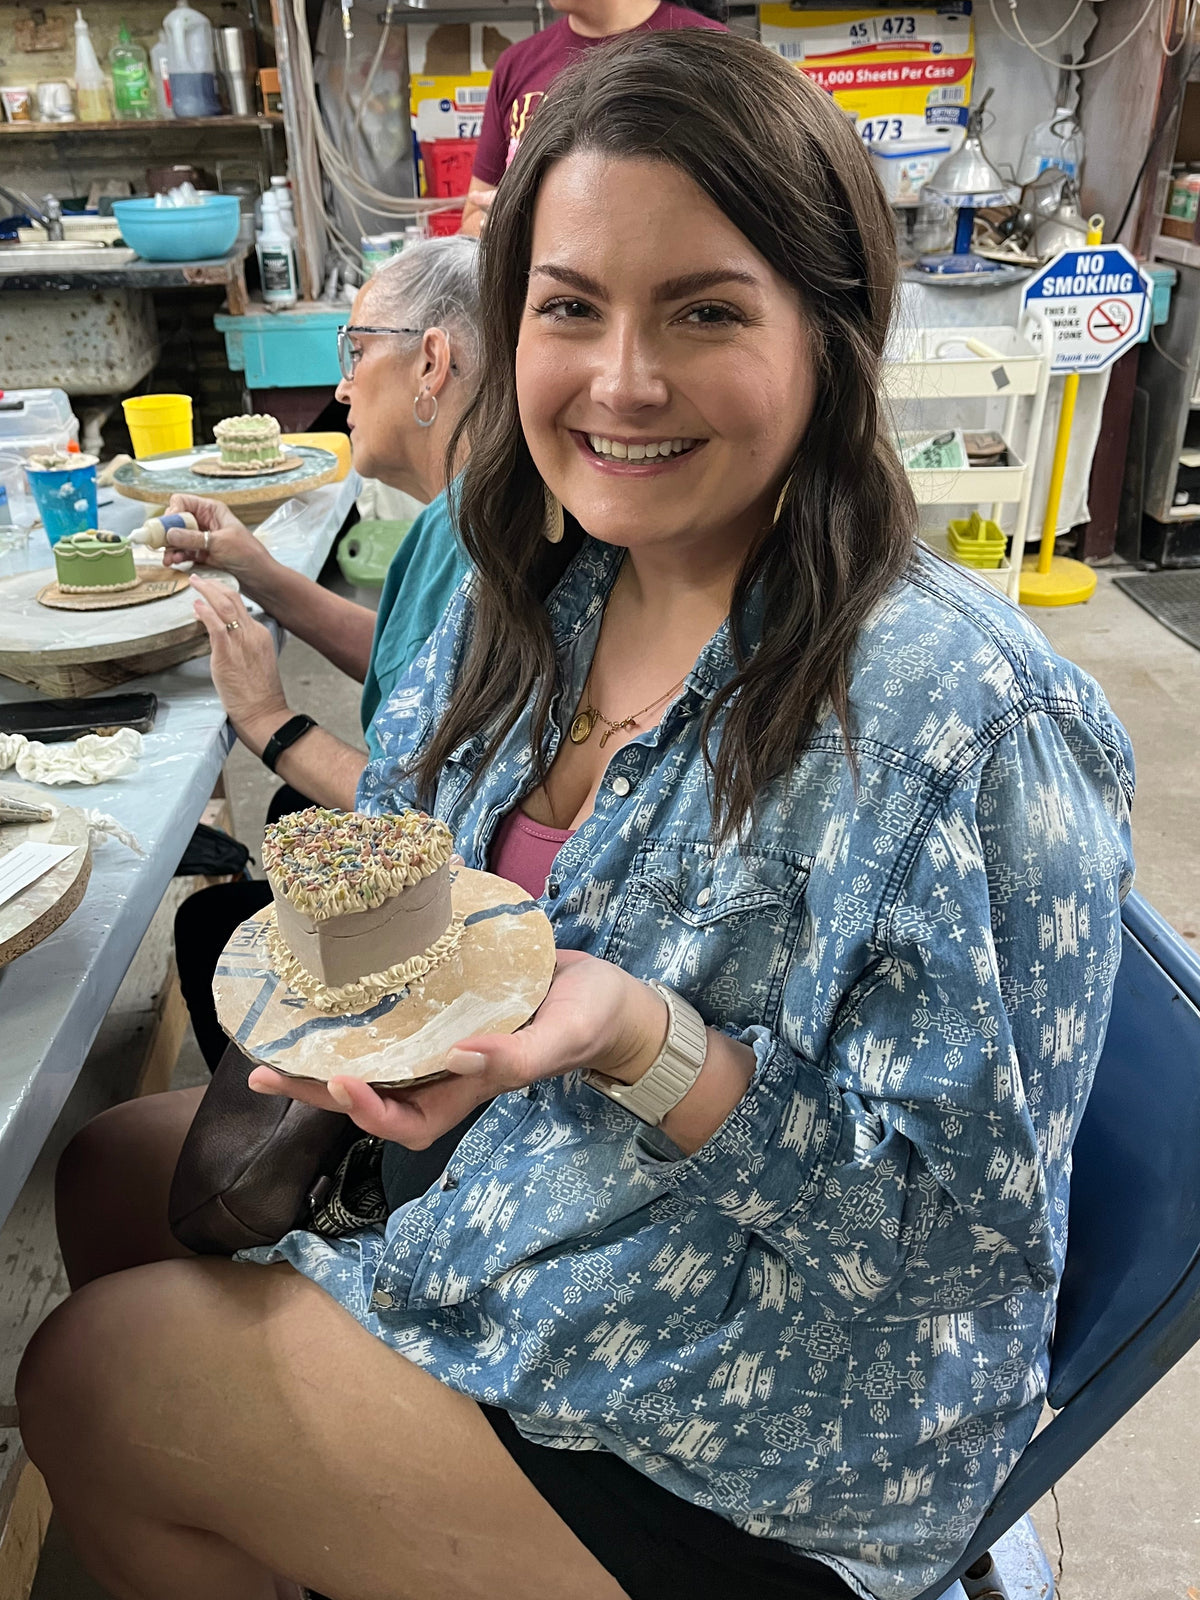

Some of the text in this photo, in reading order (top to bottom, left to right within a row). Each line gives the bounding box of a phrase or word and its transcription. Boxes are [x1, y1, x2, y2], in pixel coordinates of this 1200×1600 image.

[849, 16, 916, 37] 45 473
[856, 69, 899, 83] Sheets
[901, 67, 922, 80] Per
[925, 65, 955, 78] Case
[862, 120, 903, 142] 473
[1075, 254, 1104, 275] NO
[1041, 273, 1133, 296] SMOKING
[1045, 305, 1077, 315] THIS IS
[1053, 319, 1080, 327] MOKE
[1058, 332, 1082, 340] ZONE
[1084, 353, 1101, 362] you
